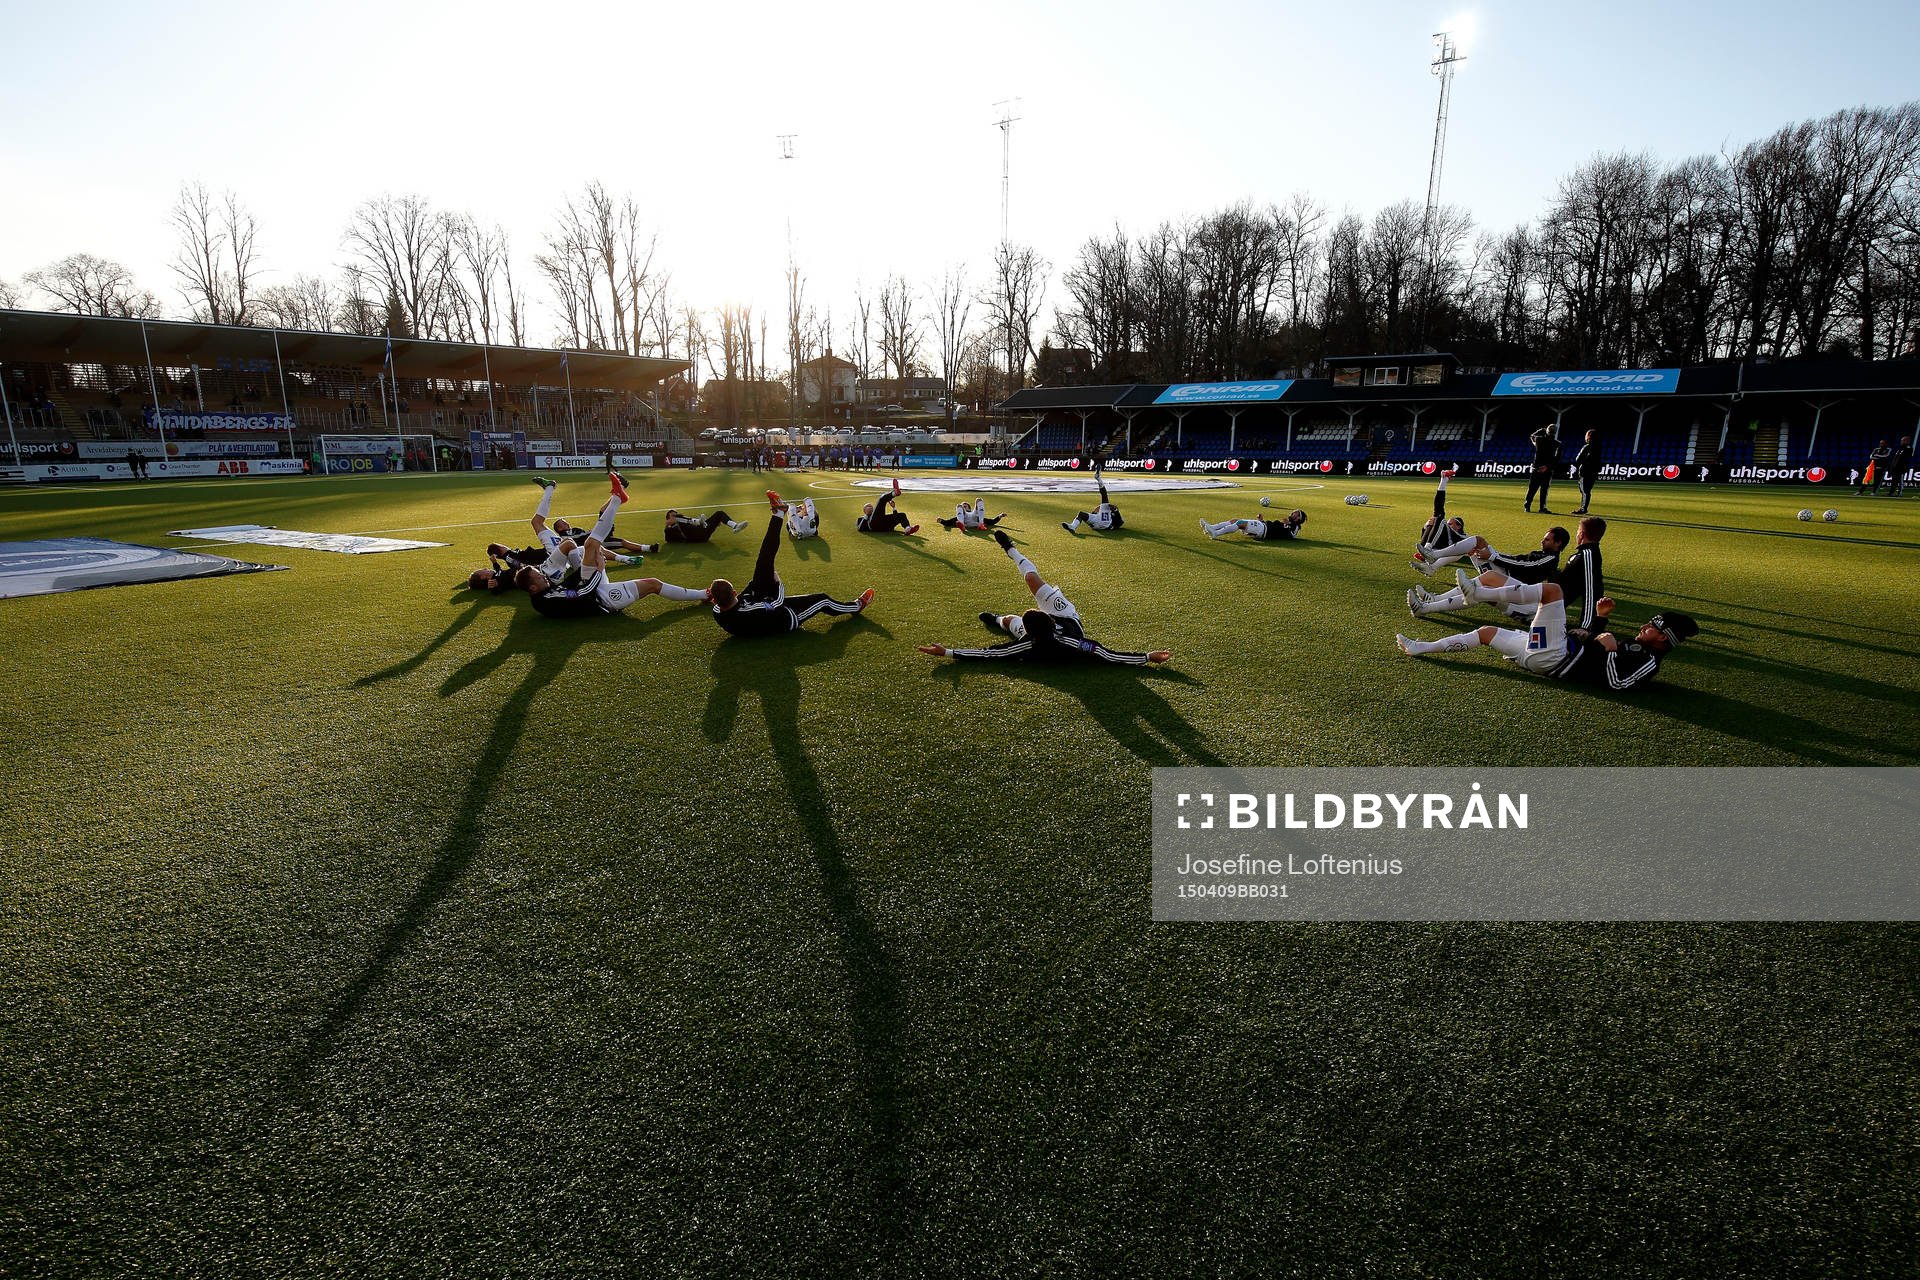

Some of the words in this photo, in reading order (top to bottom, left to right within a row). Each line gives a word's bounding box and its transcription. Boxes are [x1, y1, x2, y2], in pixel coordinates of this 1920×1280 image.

[1510, 374, 1664, 388] CONRAD
[1171, 384, 1280, 397] CONRAD
[1522, 384, 1643, 393] www.conrad.se
[723, 436, 755, 445] uhlsport
[218, 461, 249, 474] ABB
[322, 458, 374, 472] PROJOB
[556, 457, 591, 467] Thermia
[978, 457, 1009, 468] uhlsport
[1037, 458, 1071, 468] uhlsport
[1105, 458, 1145, 470] uhlsport
[1183, 459, 1227, 471] uhlsport
[1271, 460, 1320, 471] uhlsport
[1368, 461, 1422, 473] uhlsport
[1475, 462, 1535, 475] uhlsport
[1730, 466, 1805, 481] uhlsport
